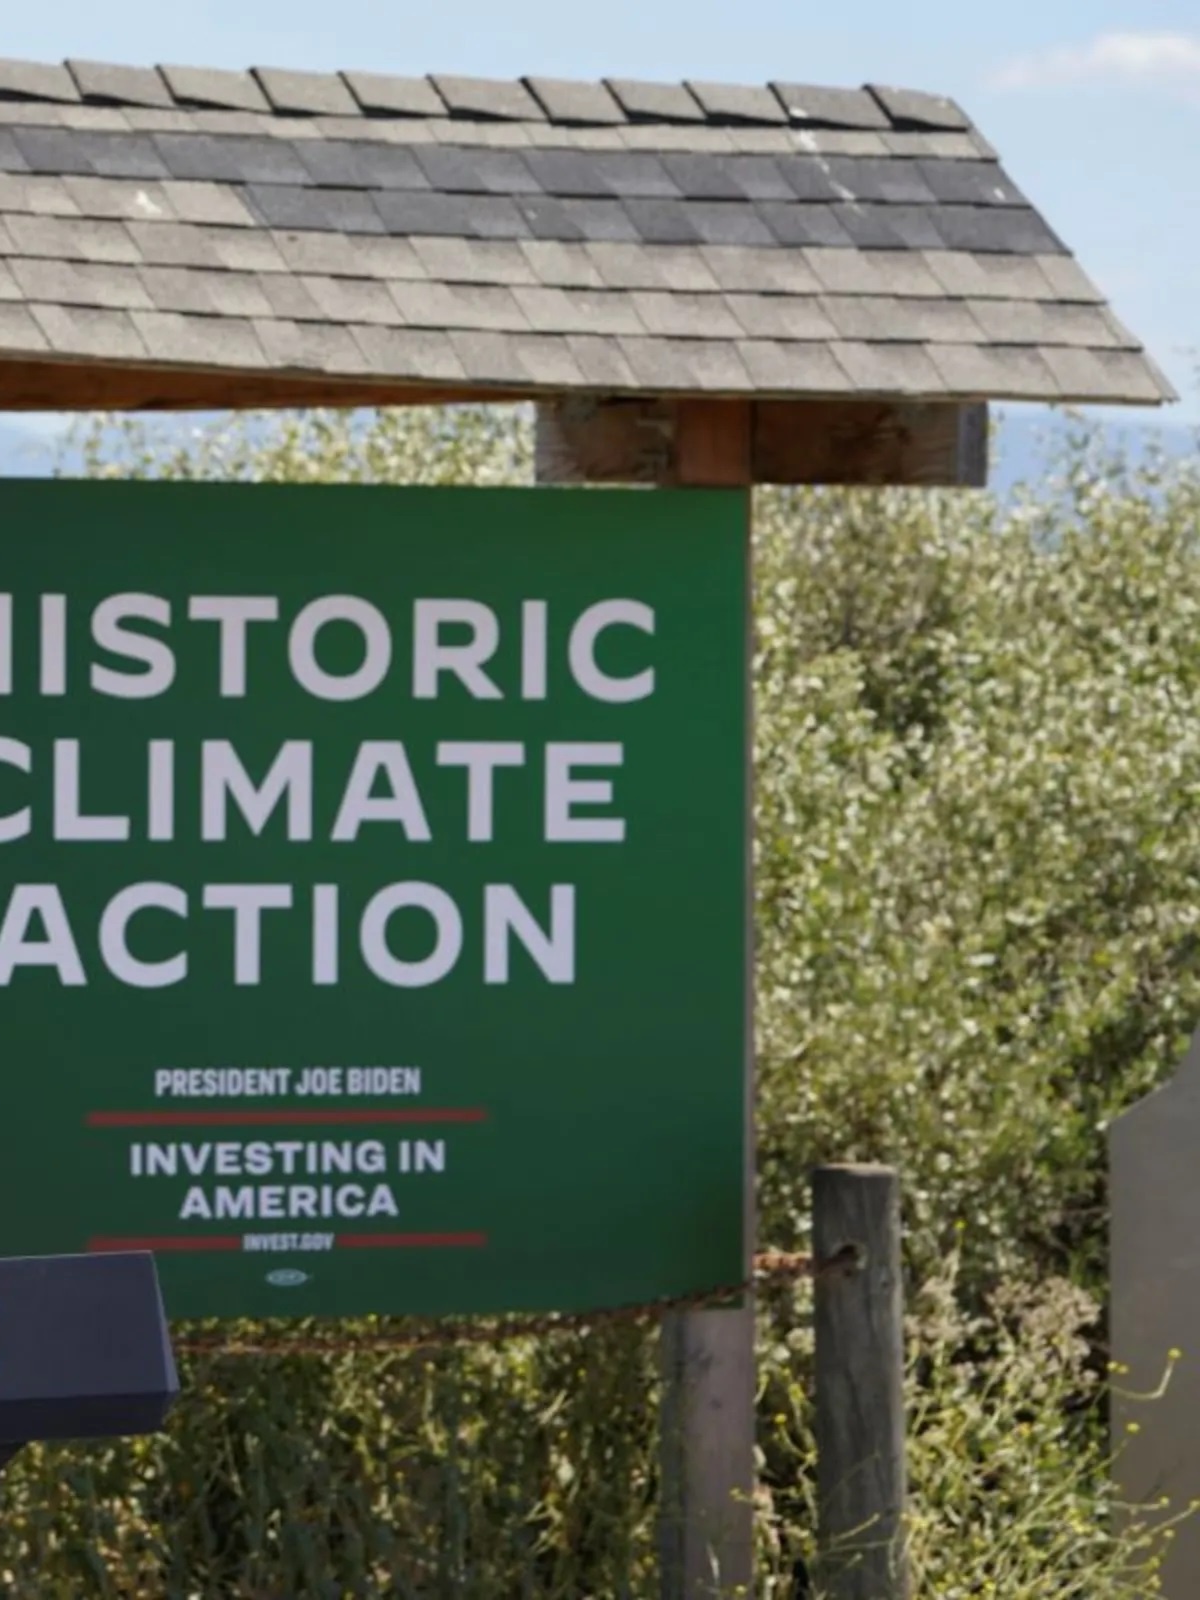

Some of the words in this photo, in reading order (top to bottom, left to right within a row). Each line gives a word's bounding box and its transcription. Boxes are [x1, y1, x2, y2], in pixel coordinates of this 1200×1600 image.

[155, 1068, 291, 1096] PRESIDENT
[296, 1068, 342, 1095] JOE
[347, 1067, 421, 1094] BIDEN
[131, 1141, 386, 1176] INVESTING
[399, 1140, 445, 1172] IN
[180, 1184, 398, 1219] AMERICA
[242, 1233, 335, 1251] INVEST.GOV
